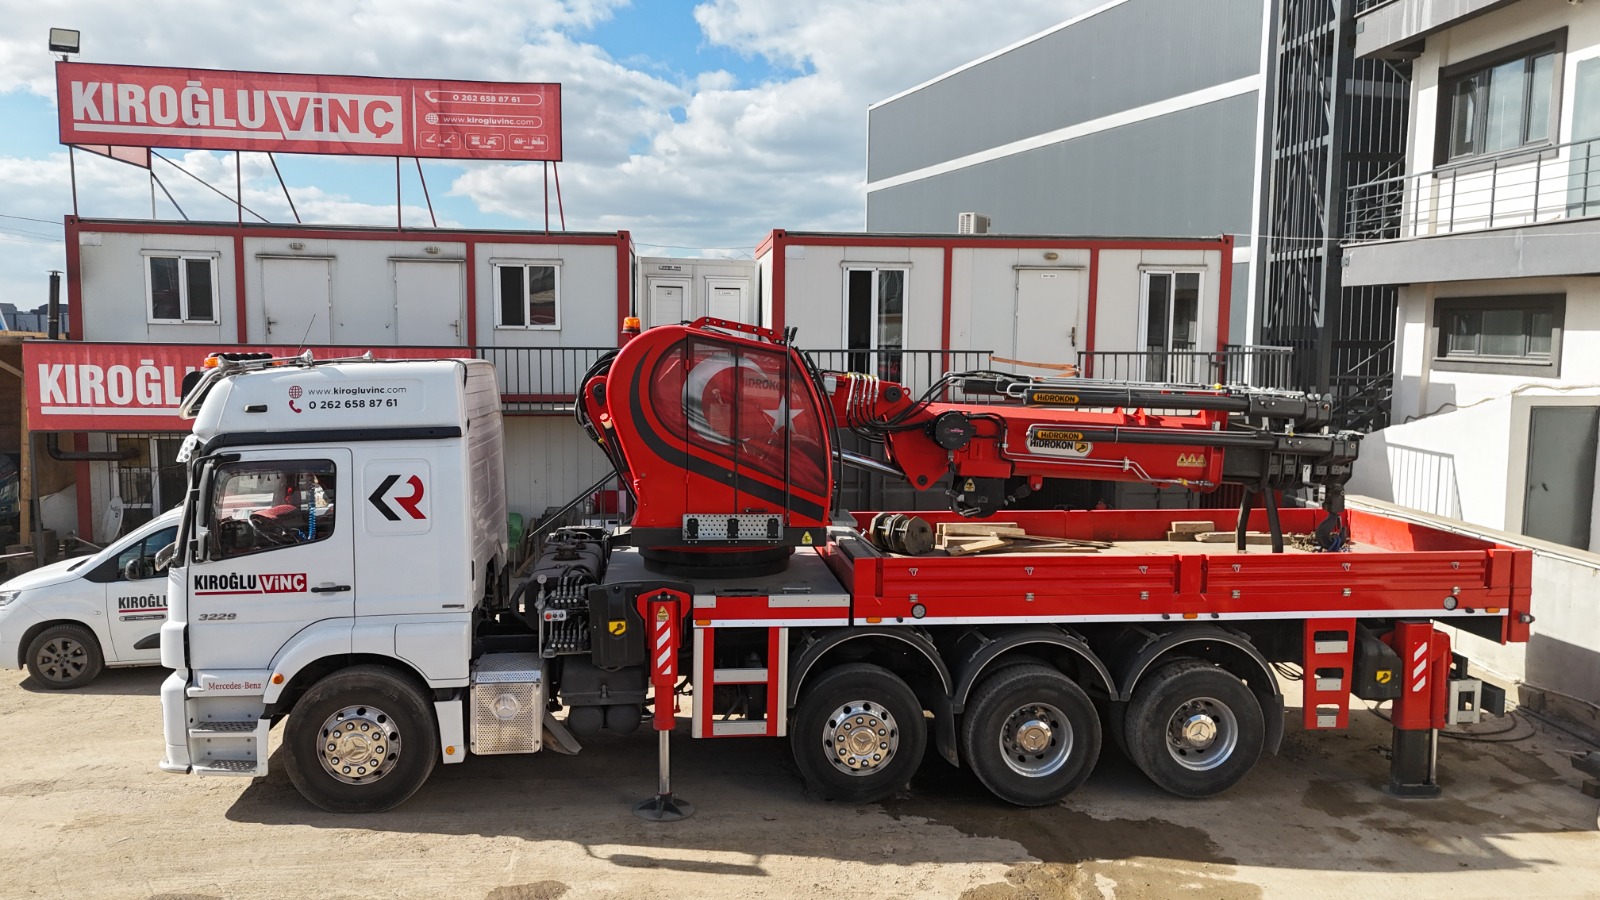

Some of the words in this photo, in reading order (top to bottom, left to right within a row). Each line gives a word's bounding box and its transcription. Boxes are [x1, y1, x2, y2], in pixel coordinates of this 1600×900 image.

[71, 81, 266, 128] KIROĞLU
[443, 116, 534, 125] www.kirogluvinc.com
[38, 359, 206, 405] KIROĞL
[308, 386, 406, 396] www.kirogluvinc.com
[309, 401, 316, 409] 0
[320, 400, 341, 409] 262
[344, 400, 365, 408] 658
[369, 399, 382, 408] 87
[386, 399, 398, 407] 61
[194, 572, 256, 590] KIROĞLU
[208, 682, 261, 690] Mercedes-Benz
